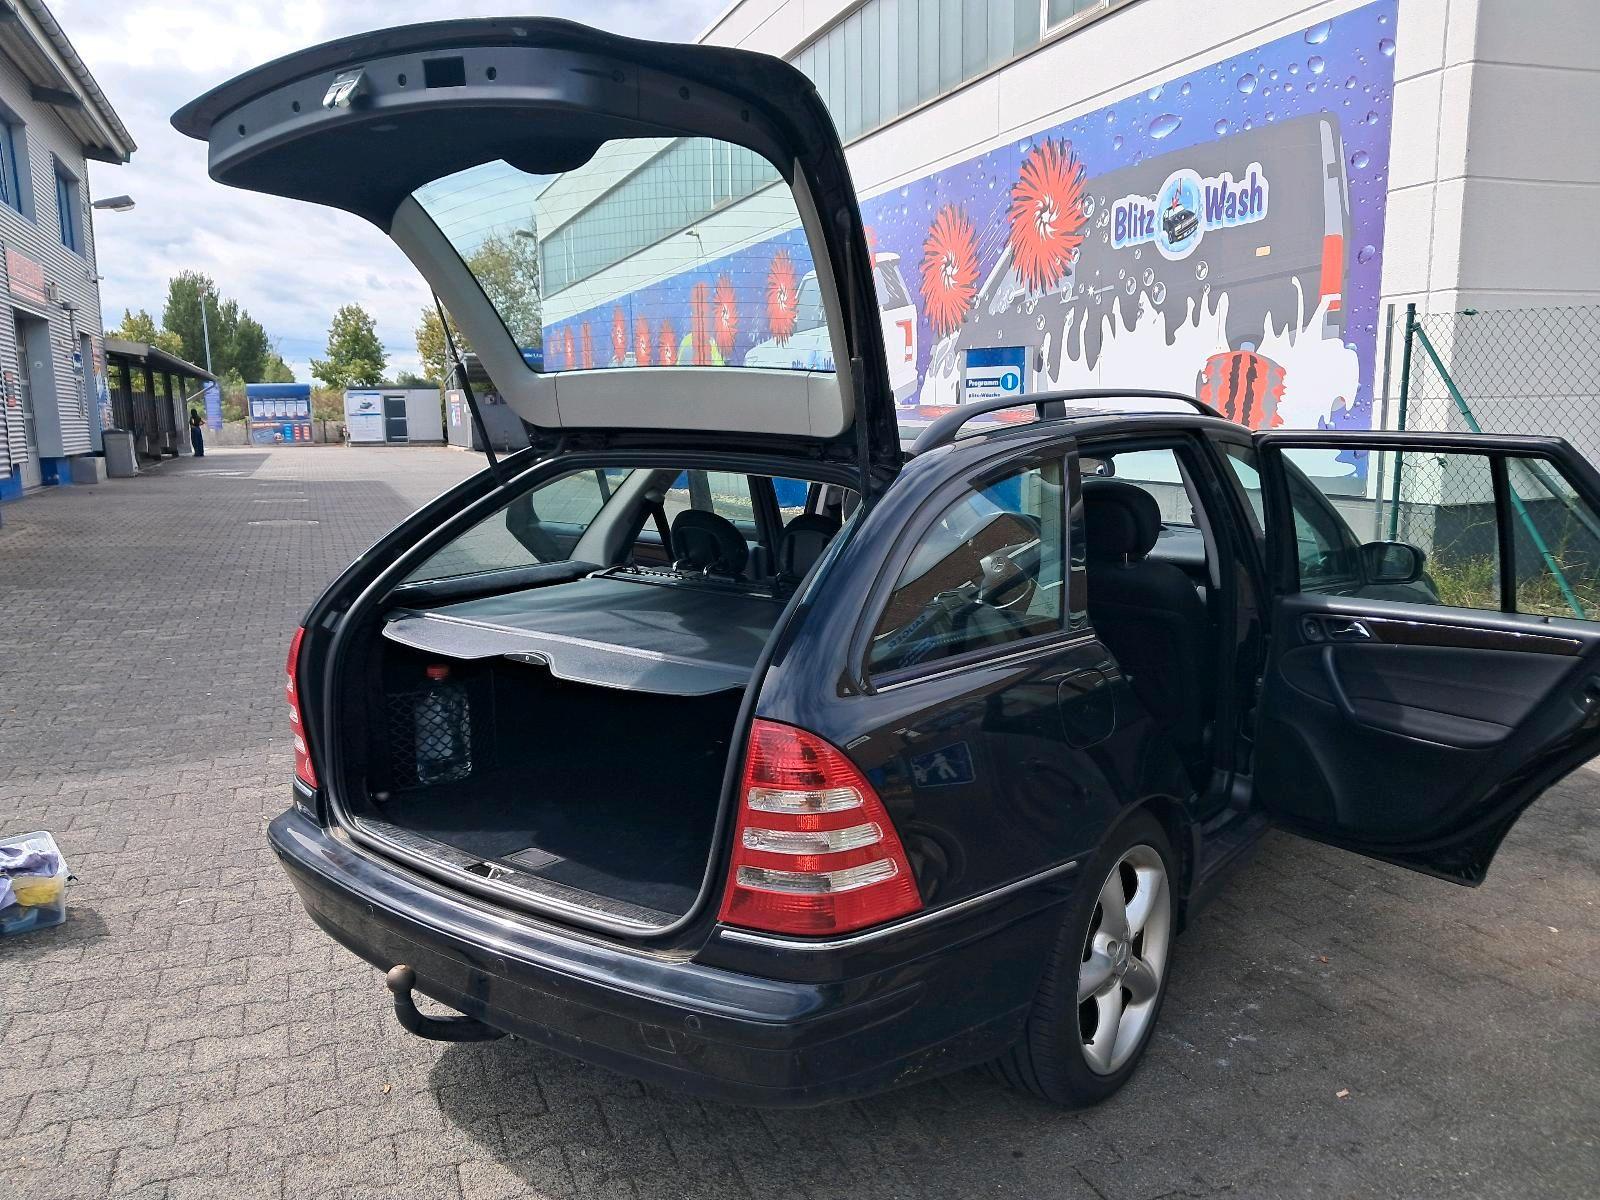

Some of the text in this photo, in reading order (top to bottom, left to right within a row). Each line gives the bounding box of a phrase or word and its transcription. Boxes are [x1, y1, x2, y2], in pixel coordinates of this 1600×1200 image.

[1114, 171, 1263, 242] Blitz Wash
[968, 374, 1013, 389] Programm 1
